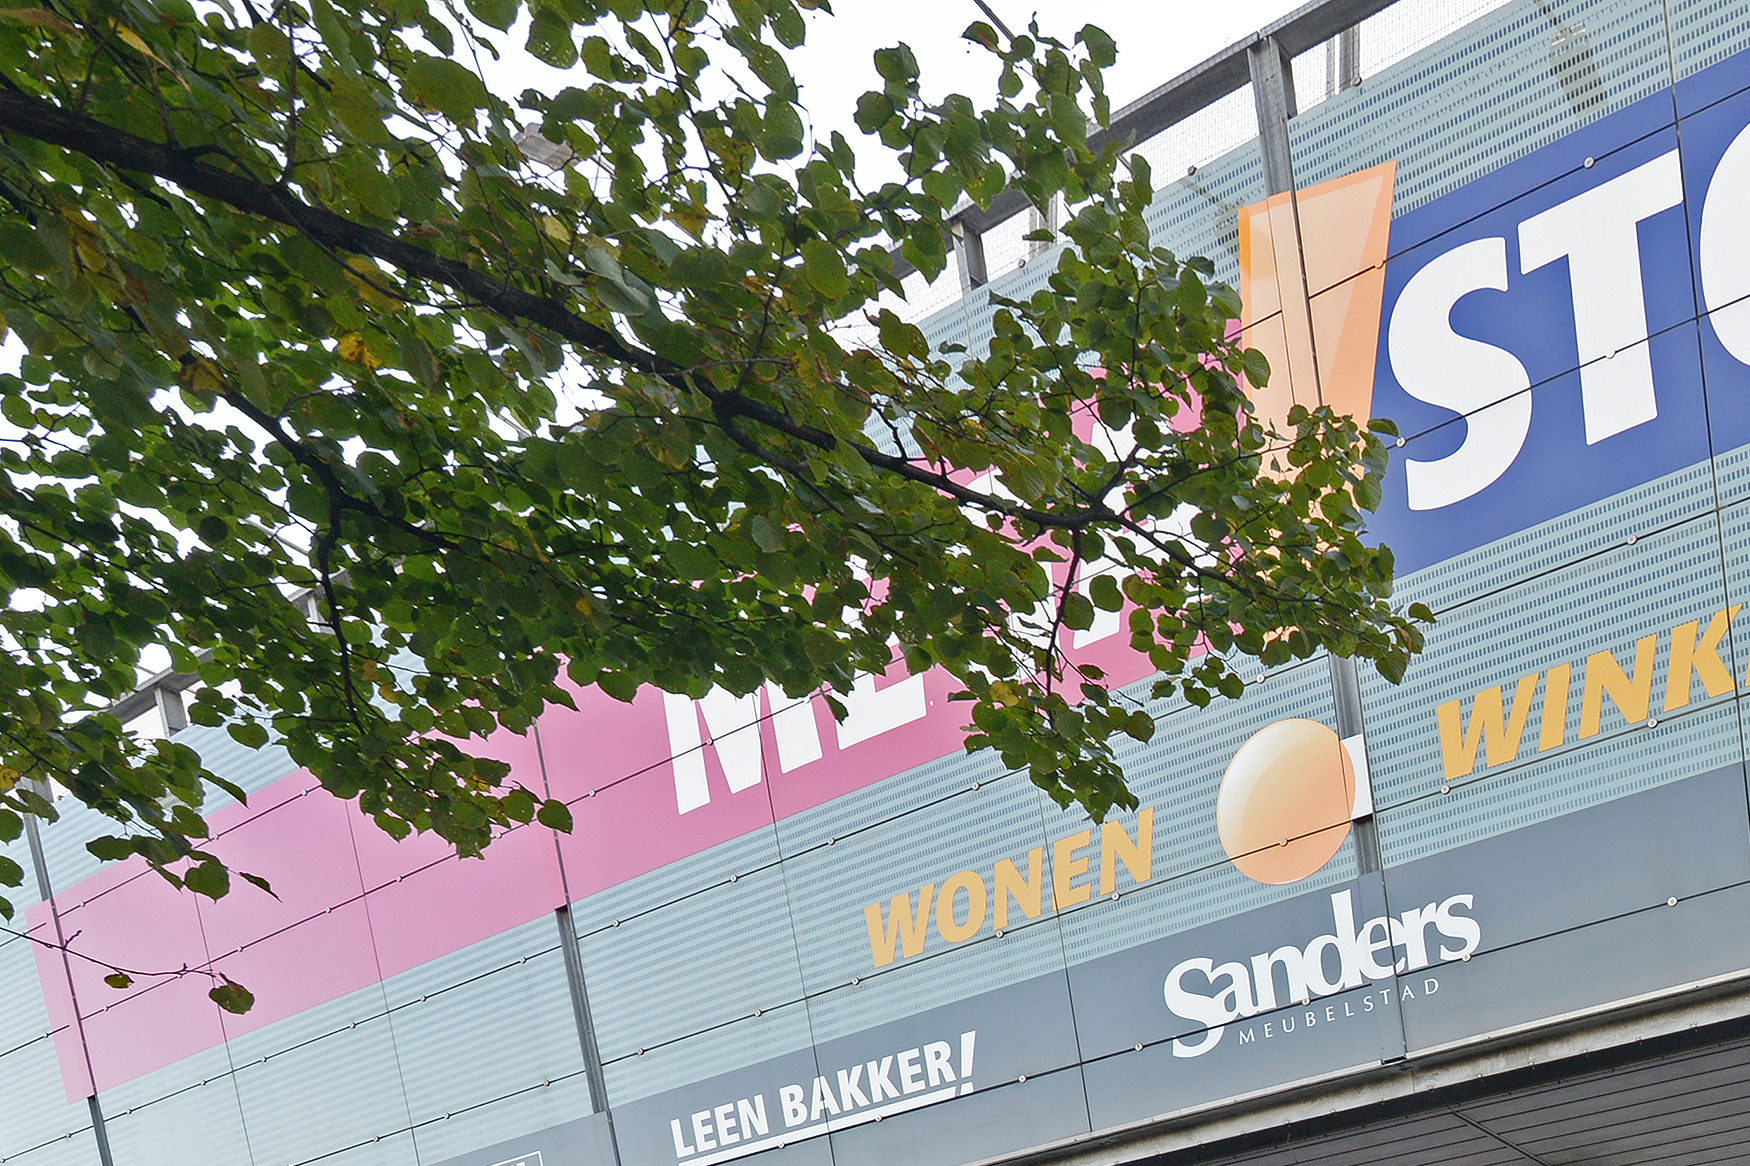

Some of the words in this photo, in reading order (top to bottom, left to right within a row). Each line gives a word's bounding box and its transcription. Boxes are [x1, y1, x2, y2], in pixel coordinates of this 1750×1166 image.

[863, 807, 1154, 968] WONEN
[1161, 889, 1482, 1058] Sanders
[1236, 978, 1442, 1046] MEUBELSTAD
[669, 1093, 769, 1160] LEEN
[785, 1031, 977, 1131] BAKKER!
